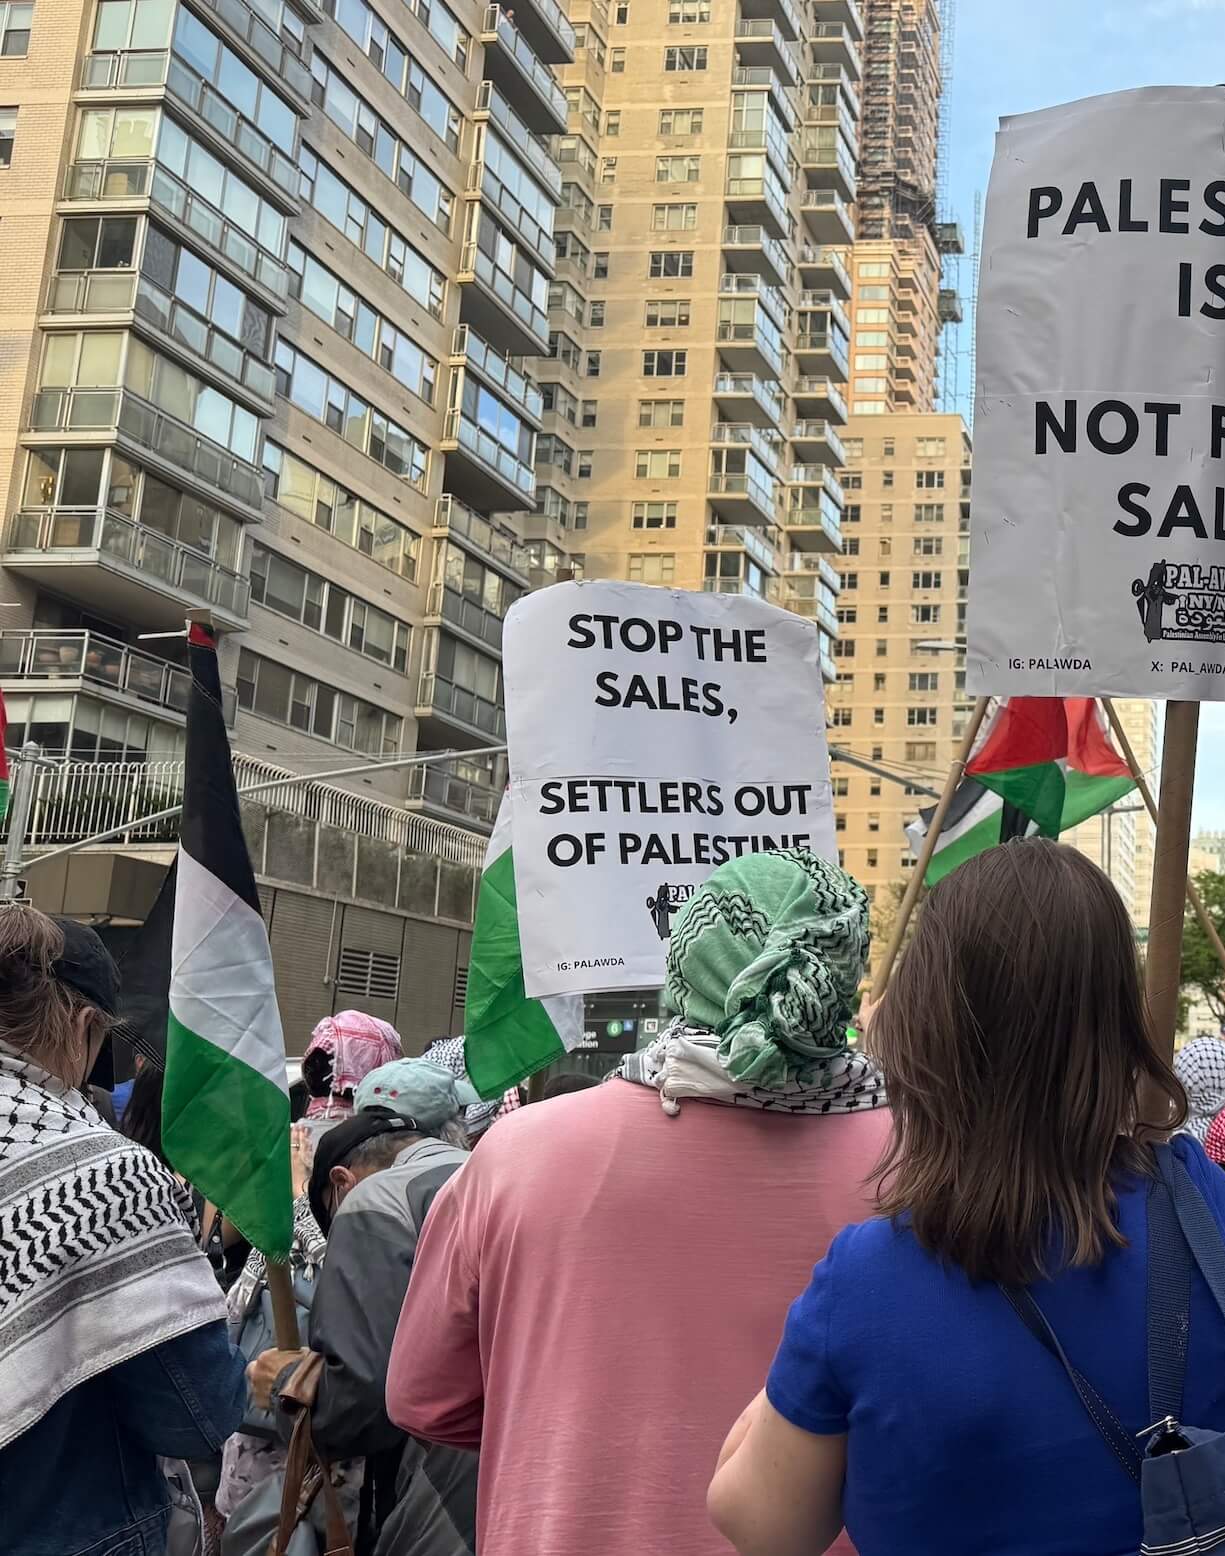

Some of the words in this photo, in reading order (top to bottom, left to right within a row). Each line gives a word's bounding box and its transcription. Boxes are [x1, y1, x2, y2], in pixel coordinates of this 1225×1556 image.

[1035, 399, 1181, 458] NOT
[567, 614, 683, 653] STOP
[690, 624, 767, 662] THE
[1009, 658, 1025, 670] IG:
[1028, 658, 1092, 671] PALAWDA
[1151, 661, 1164, 672] X:
[595, 671, 738, 724] SALES,
[539, 780, 724, 816] SETTLERS
[734, 784, 812, 816] OUT
[547, 832, 605, 867] OF
[557, 962, 570, 971] IG:
[573, 957, 625, 970] PALAWDA
